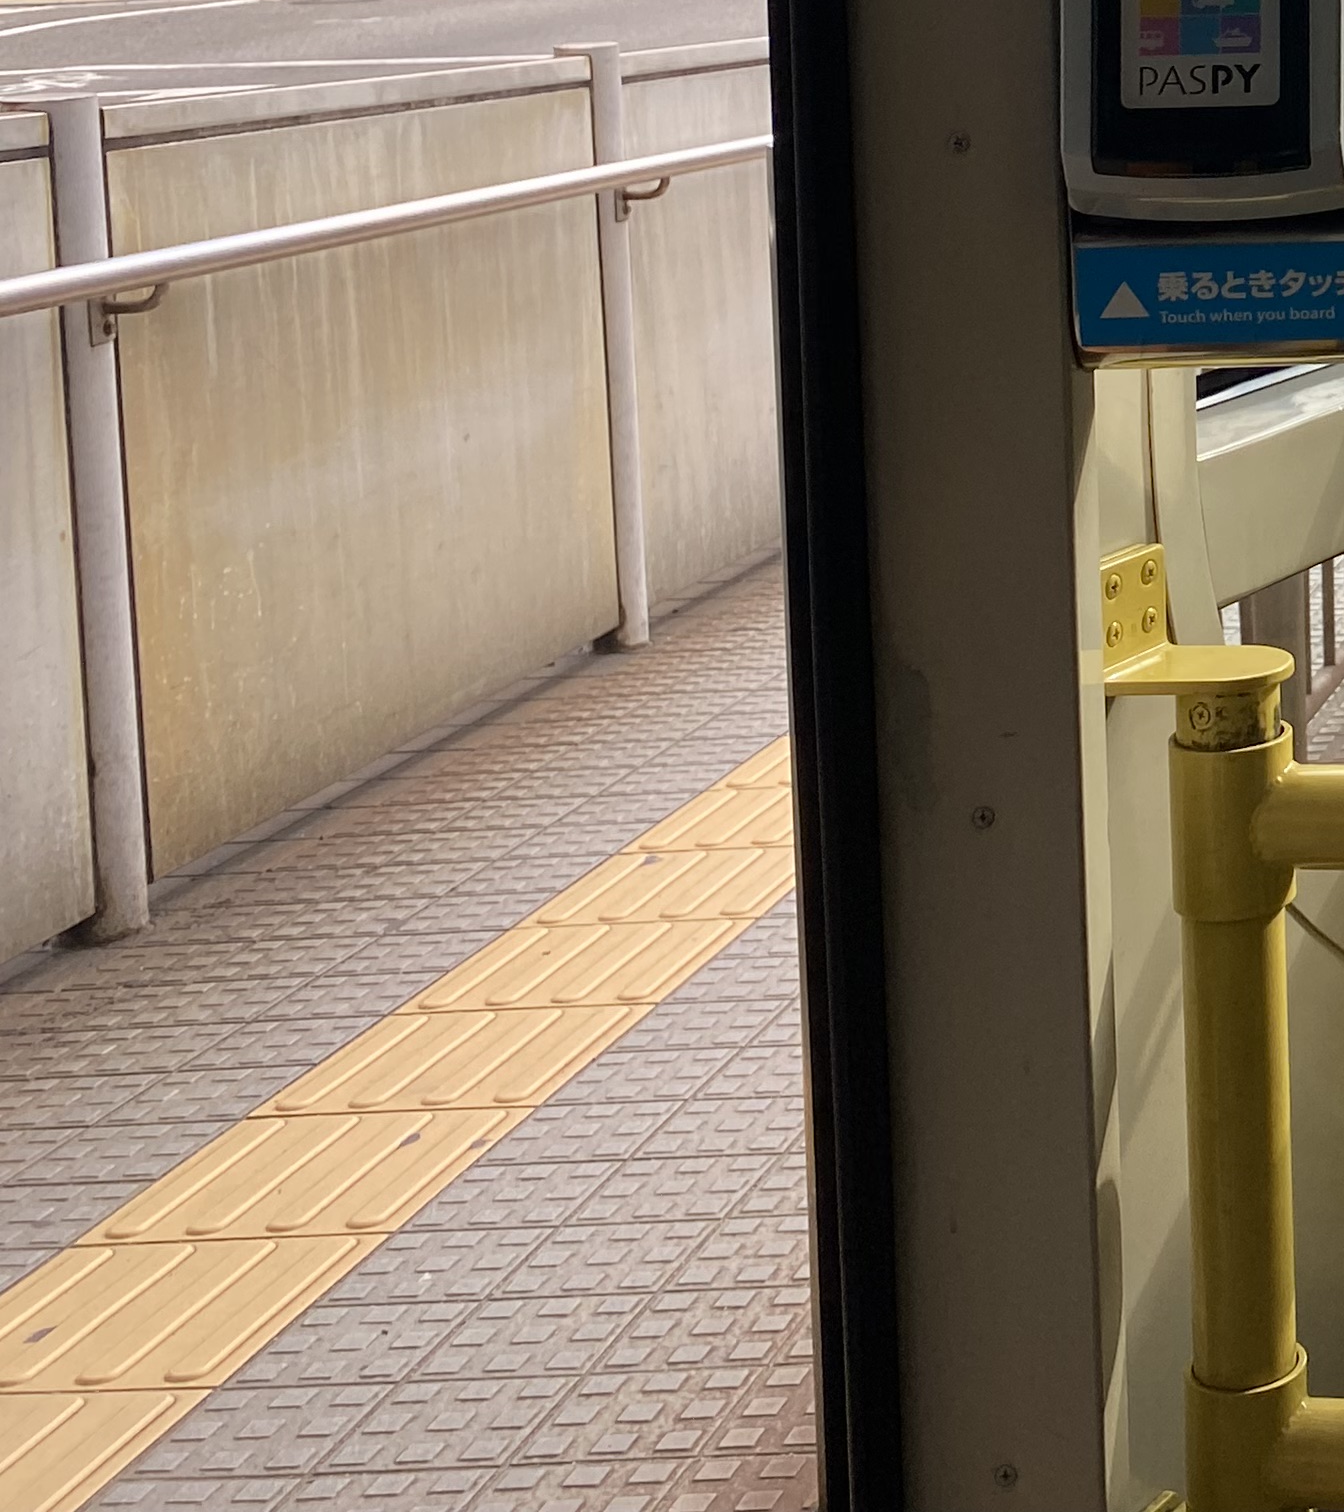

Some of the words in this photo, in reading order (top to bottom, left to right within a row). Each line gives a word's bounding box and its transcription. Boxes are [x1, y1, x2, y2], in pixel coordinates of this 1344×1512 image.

[1138, 63, 1262, 96] PASPY
[1160, 309, 1206, 324] Touch
[1210, 309, 1252, 322] when
[1256, 310, 1287, 324] you
[1289, 306, 1336, 321] board
